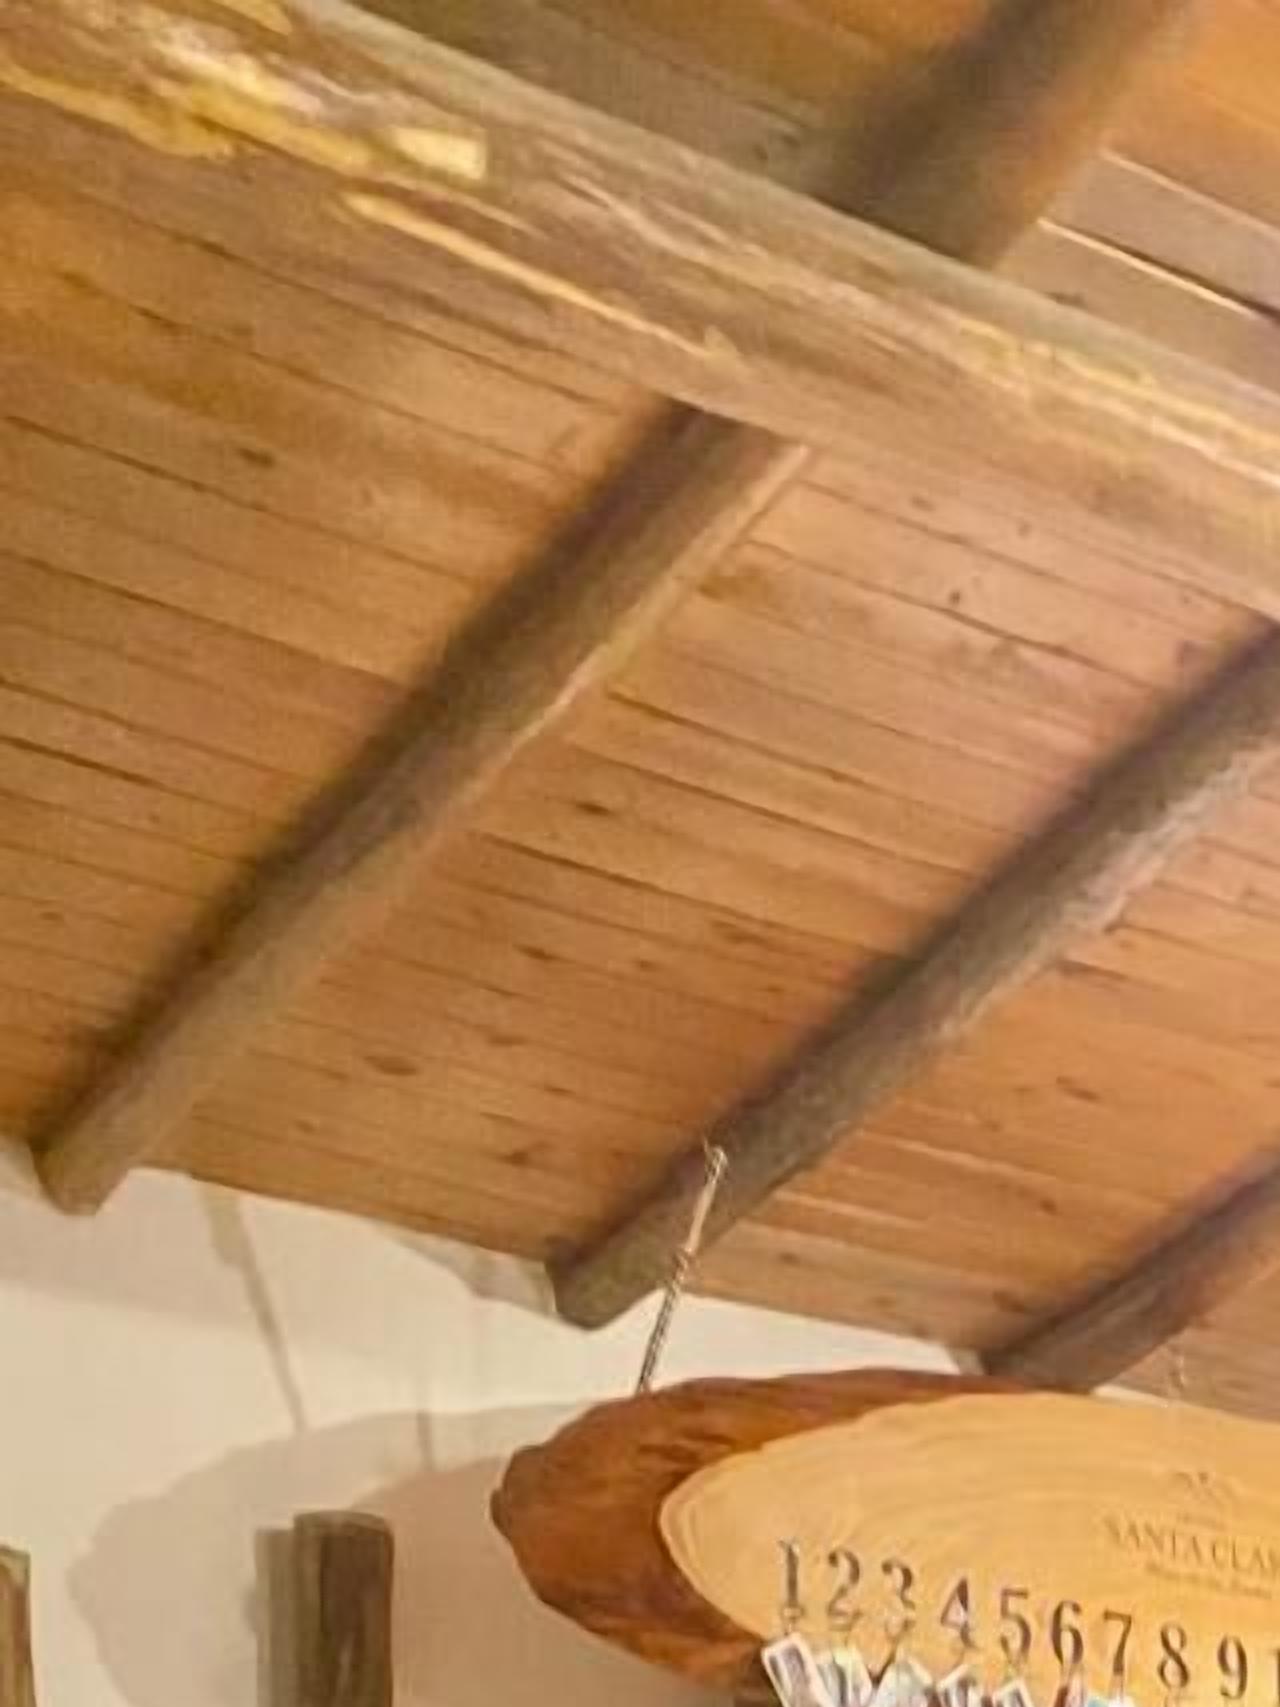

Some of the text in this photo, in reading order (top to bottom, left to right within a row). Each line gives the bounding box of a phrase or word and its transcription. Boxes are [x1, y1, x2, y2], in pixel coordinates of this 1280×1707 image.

[779, 1538, 804, 1622] 1
[827, 1547, 862, 1624] 2
[939, 1576, 982, 1648] 4
[998, 1587, 1032, 1667] 5
[1050, 1600, 1085, 1667] 6
[1103, 1609, 1133, 1676] 7
[1156, 1622, 1190, 1690] 8
[1217, 1635, 1249, 1701] 9
